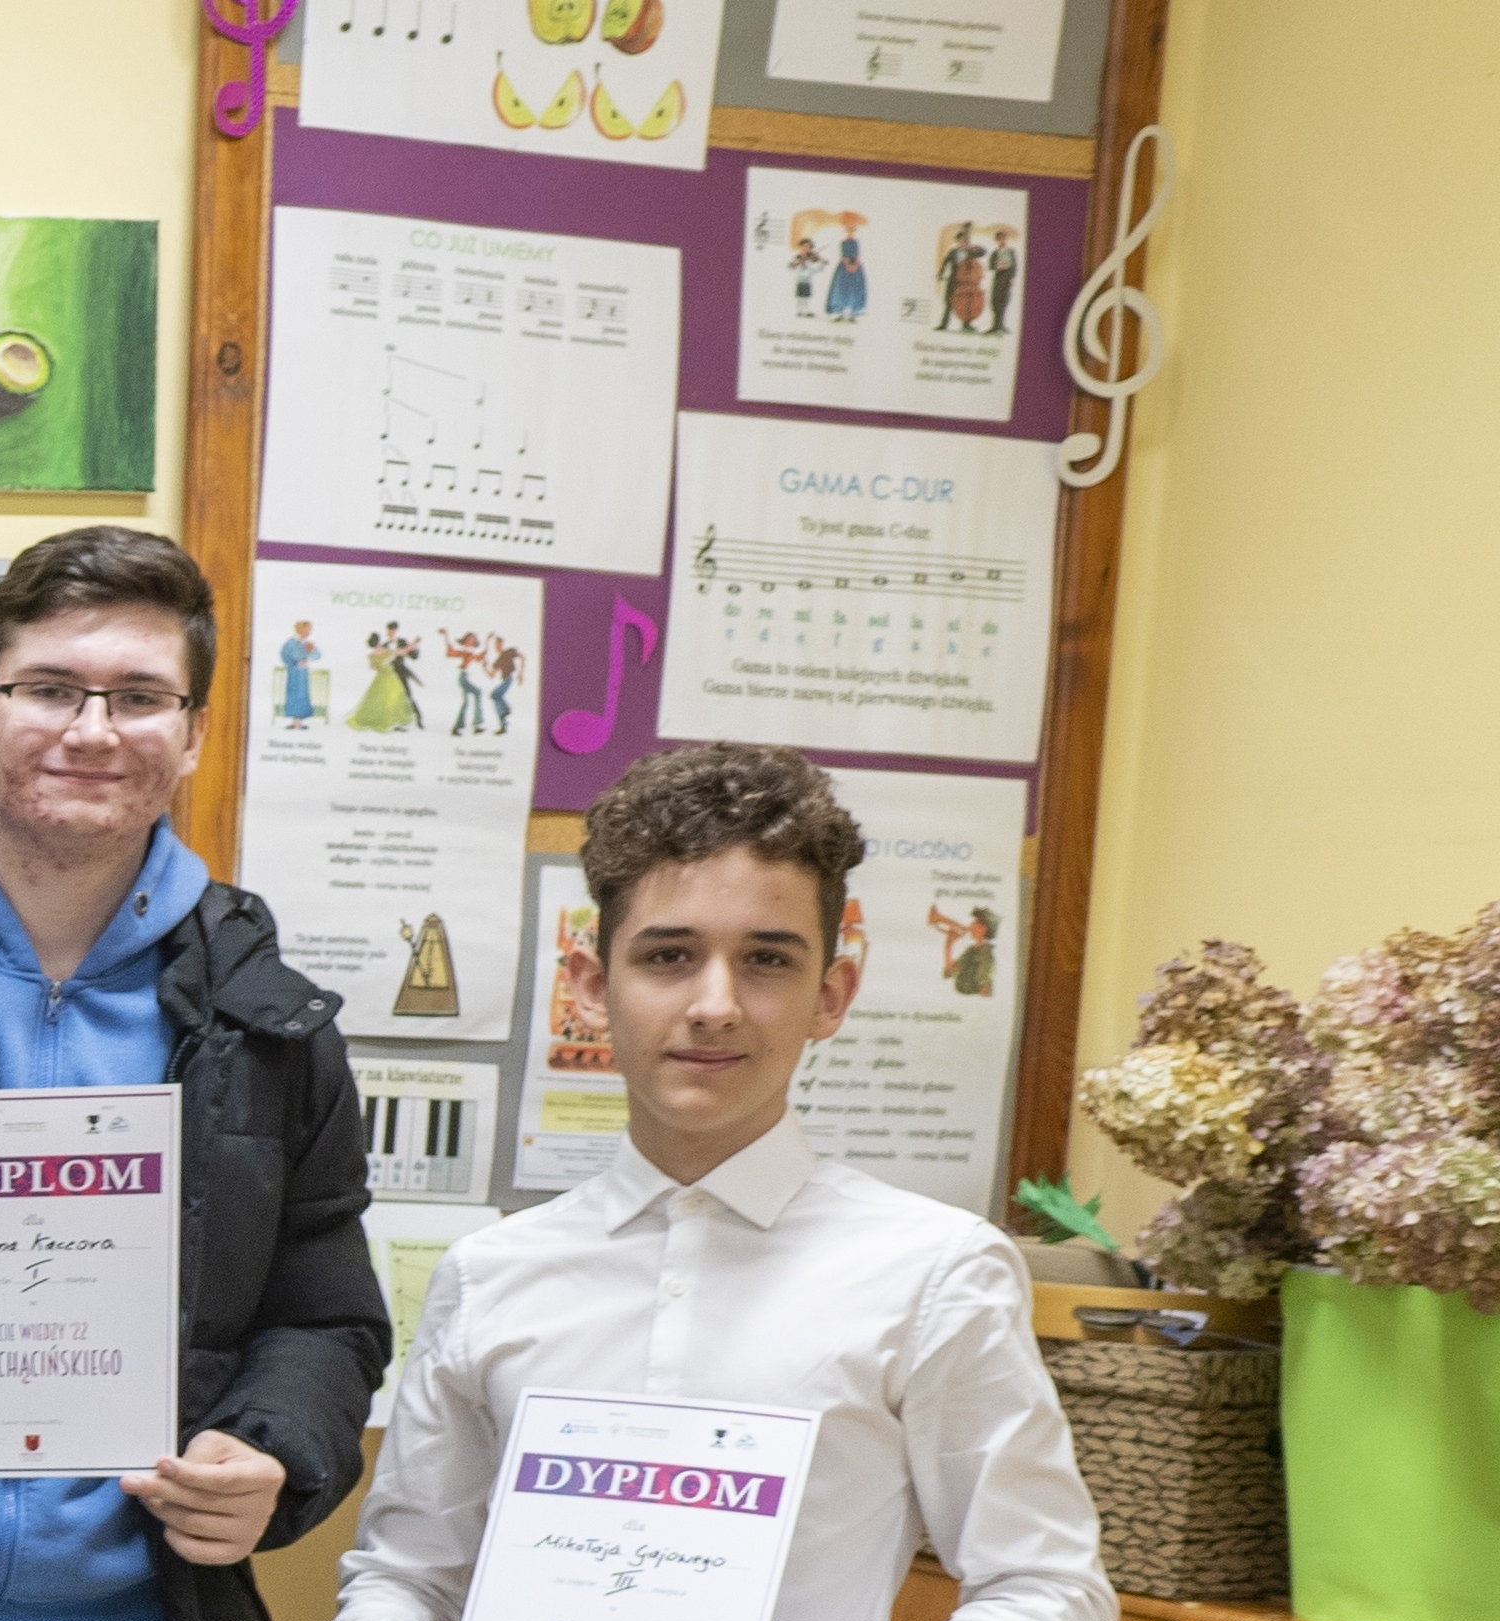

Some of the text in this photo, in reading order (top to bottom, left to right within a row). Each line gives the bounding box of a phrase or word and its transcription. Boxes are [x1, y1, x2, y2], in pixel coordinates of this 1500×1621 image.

[779, 467, 956, 502] GAMA C-DUR
[533, 1457, 765, 1511] DYPLOM
